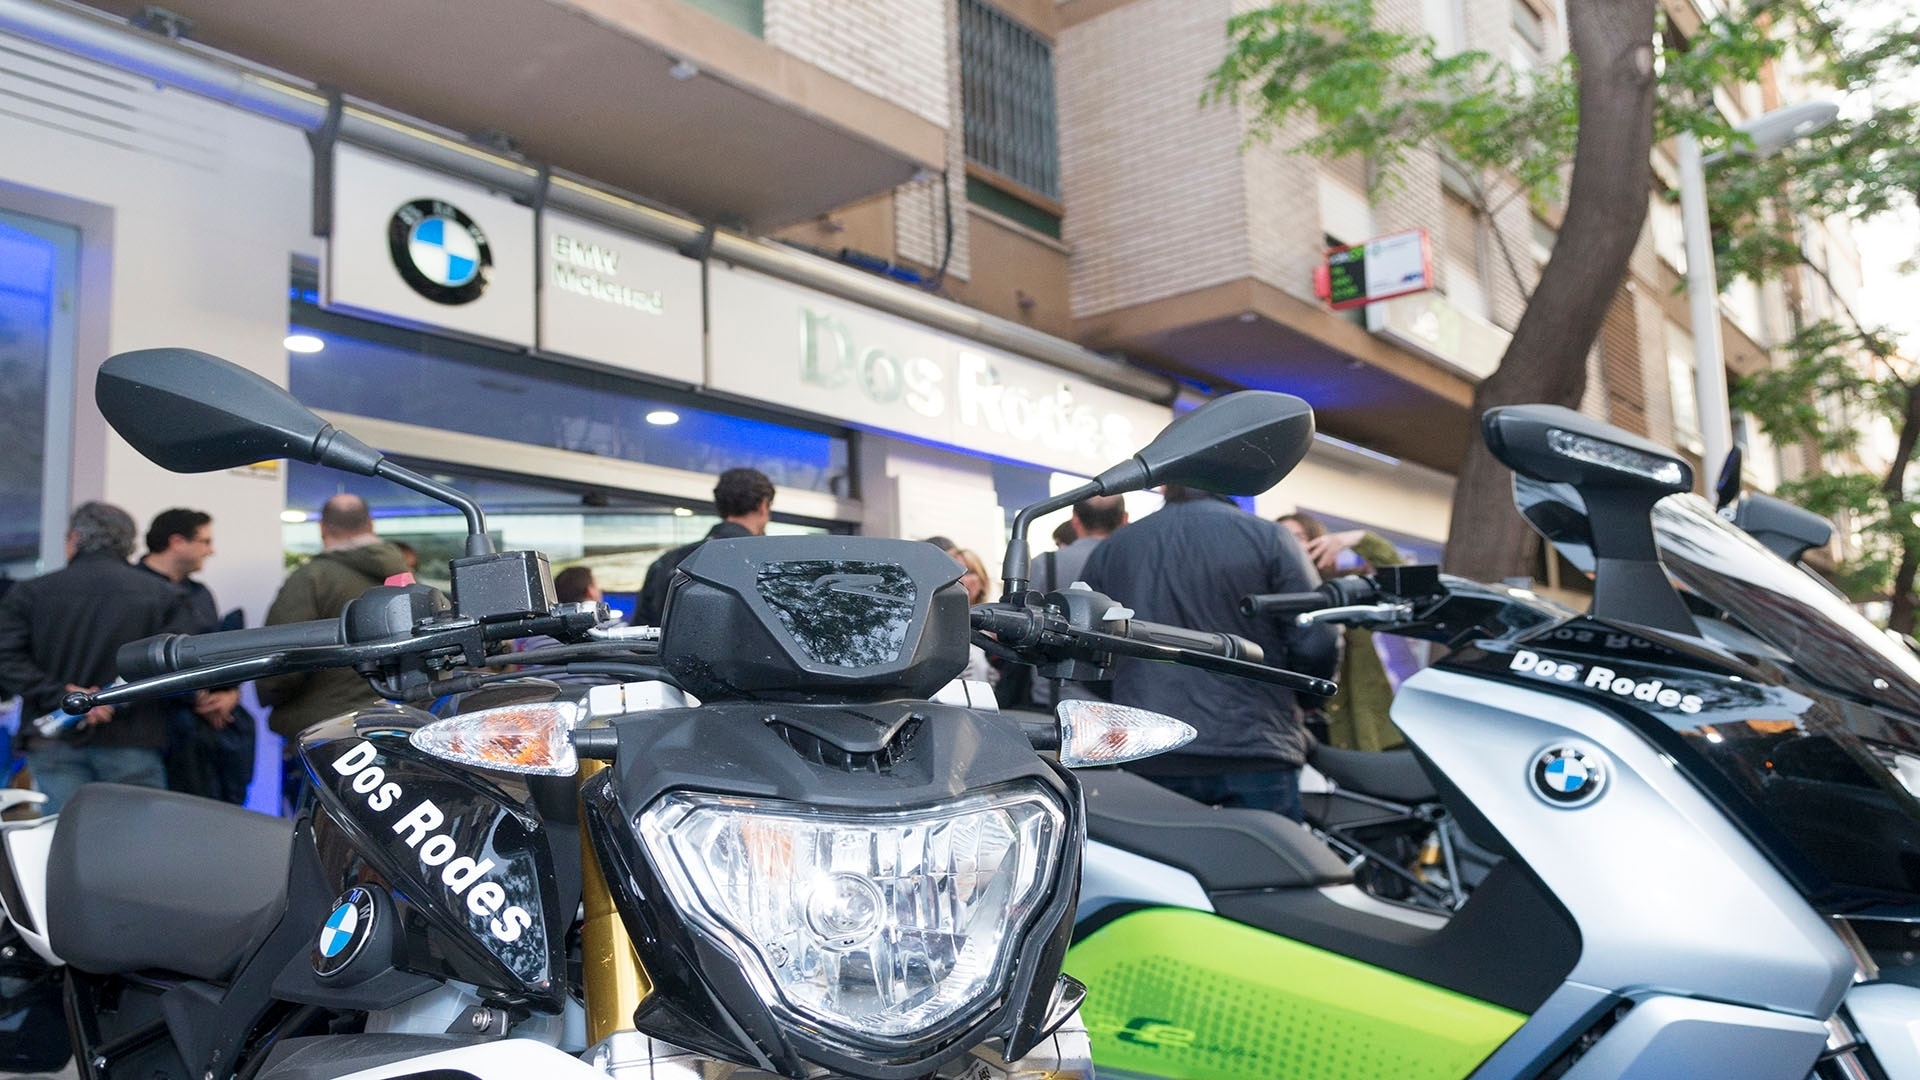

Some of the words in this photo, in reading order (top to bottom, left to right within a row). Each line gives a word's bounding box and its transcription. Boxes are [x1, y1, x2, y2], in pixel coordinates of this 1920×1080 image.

[551, 233, 620, 276] BMW
[799, 303, 947, 418] Dos
[957, 350, 1136, 465] Rodes
[1509, 650, 1579, 682] Dos
[1584, 666, 1704, 714] Rodes
[331, 740, 403, 812] Dos
[391, 799, 532, 943] Rodes
[332, 889, 371, 920] BMW
